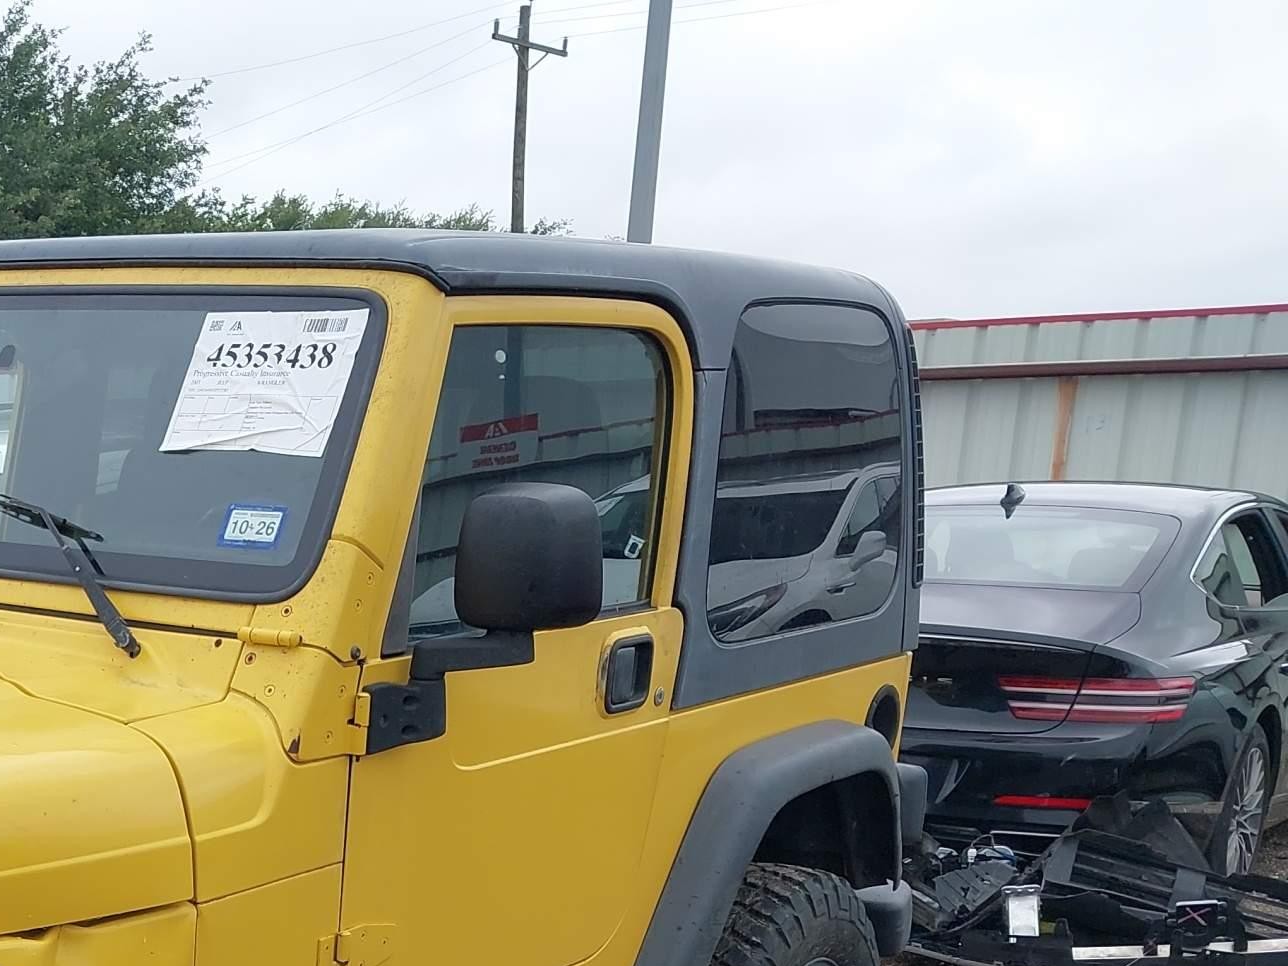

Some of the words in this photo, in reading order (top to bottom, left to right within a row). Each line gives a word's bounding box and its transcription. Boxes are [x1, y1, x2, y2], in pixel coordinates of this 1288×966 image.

[206, 341, 338, 370] 45353438
[192, 369, 229, 378] Progressive
[230, 369, 258, 378] Casualty
[259, 370, 291, 378] Insurance
